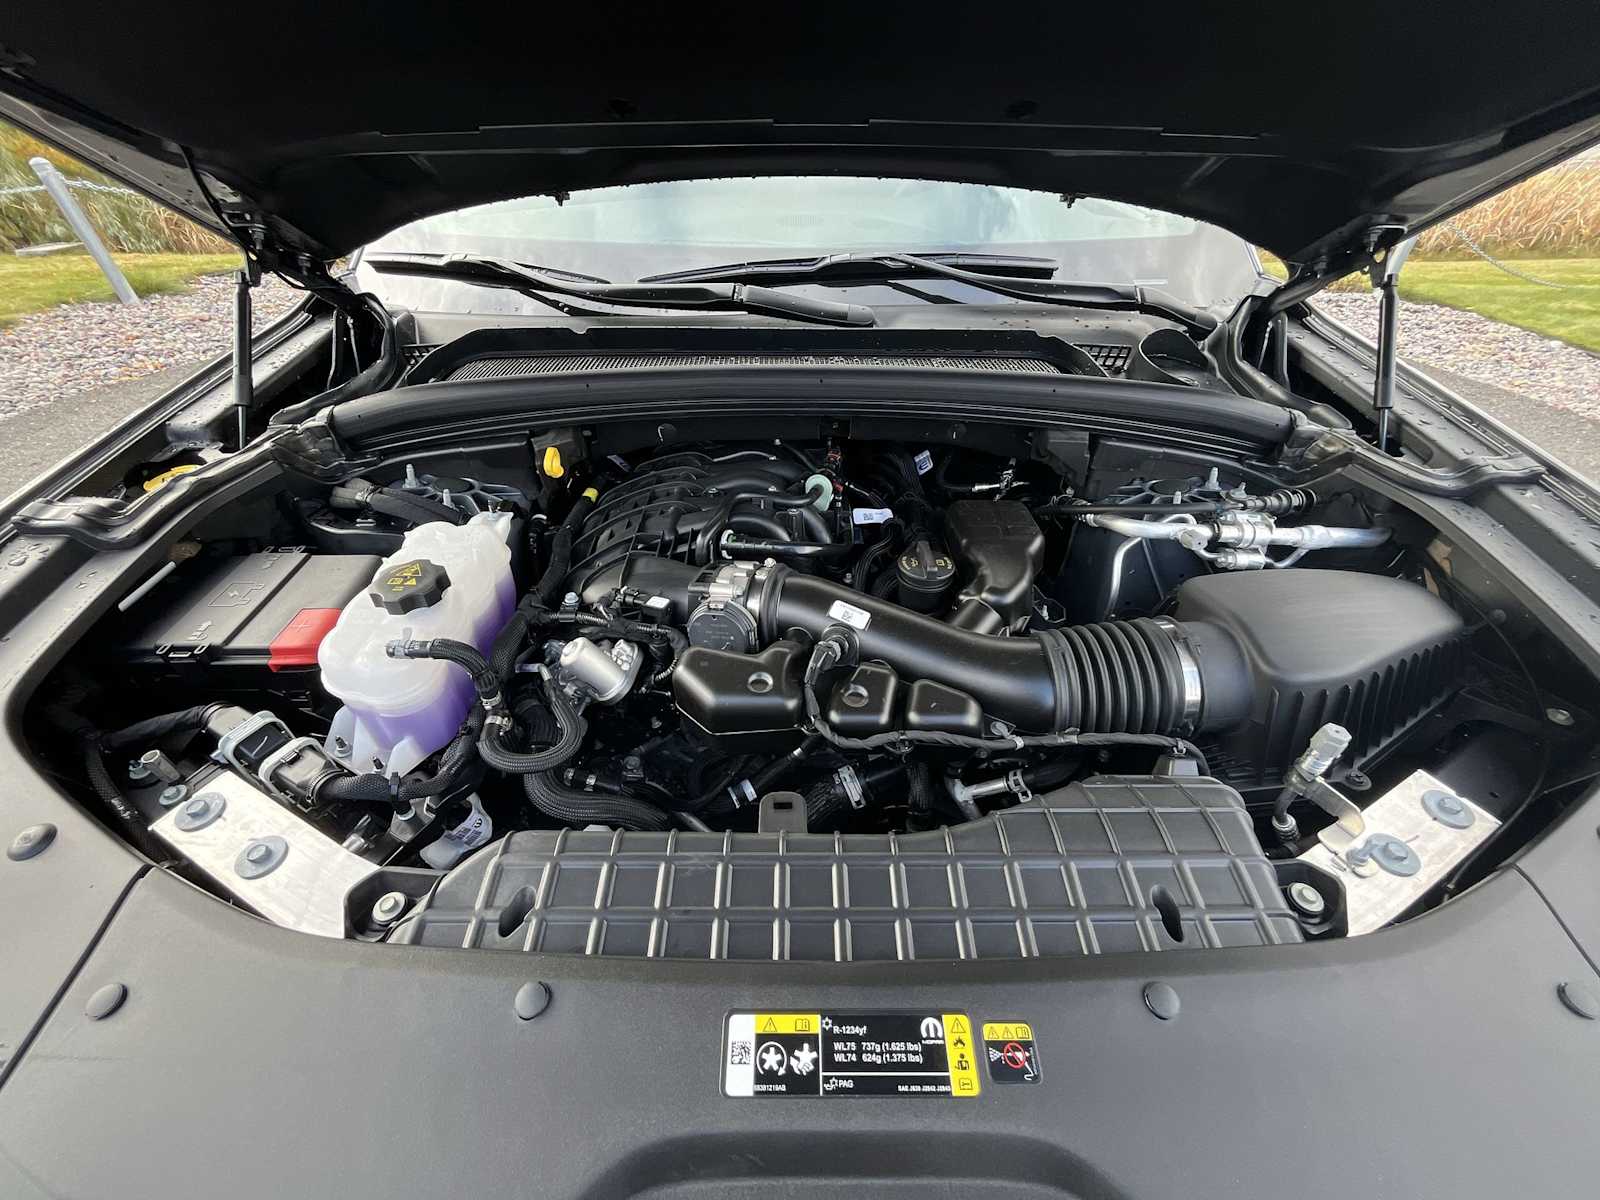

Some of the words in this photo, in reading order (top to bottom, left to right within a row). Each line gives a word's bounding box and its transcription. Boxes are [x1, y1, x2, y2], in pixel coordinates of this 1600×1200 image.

[833, 1025, 867, 1036] R-1234yf
[833, 1042, 857, 1051] WL75
[861, 1042, 880, 1053] 737g
[882, 1042, 906, 1053] (1.625
[907, 1042, 922, 1053] lbs)
[834, 1053, 857, 1062] WL74
[862, 1053, 881, 1064] 624g
[883, 1053, 907, 1064] (1.375
[908, 1053, 923, 1064] lbs)
[838, 1080, 854, 1089] PAG
